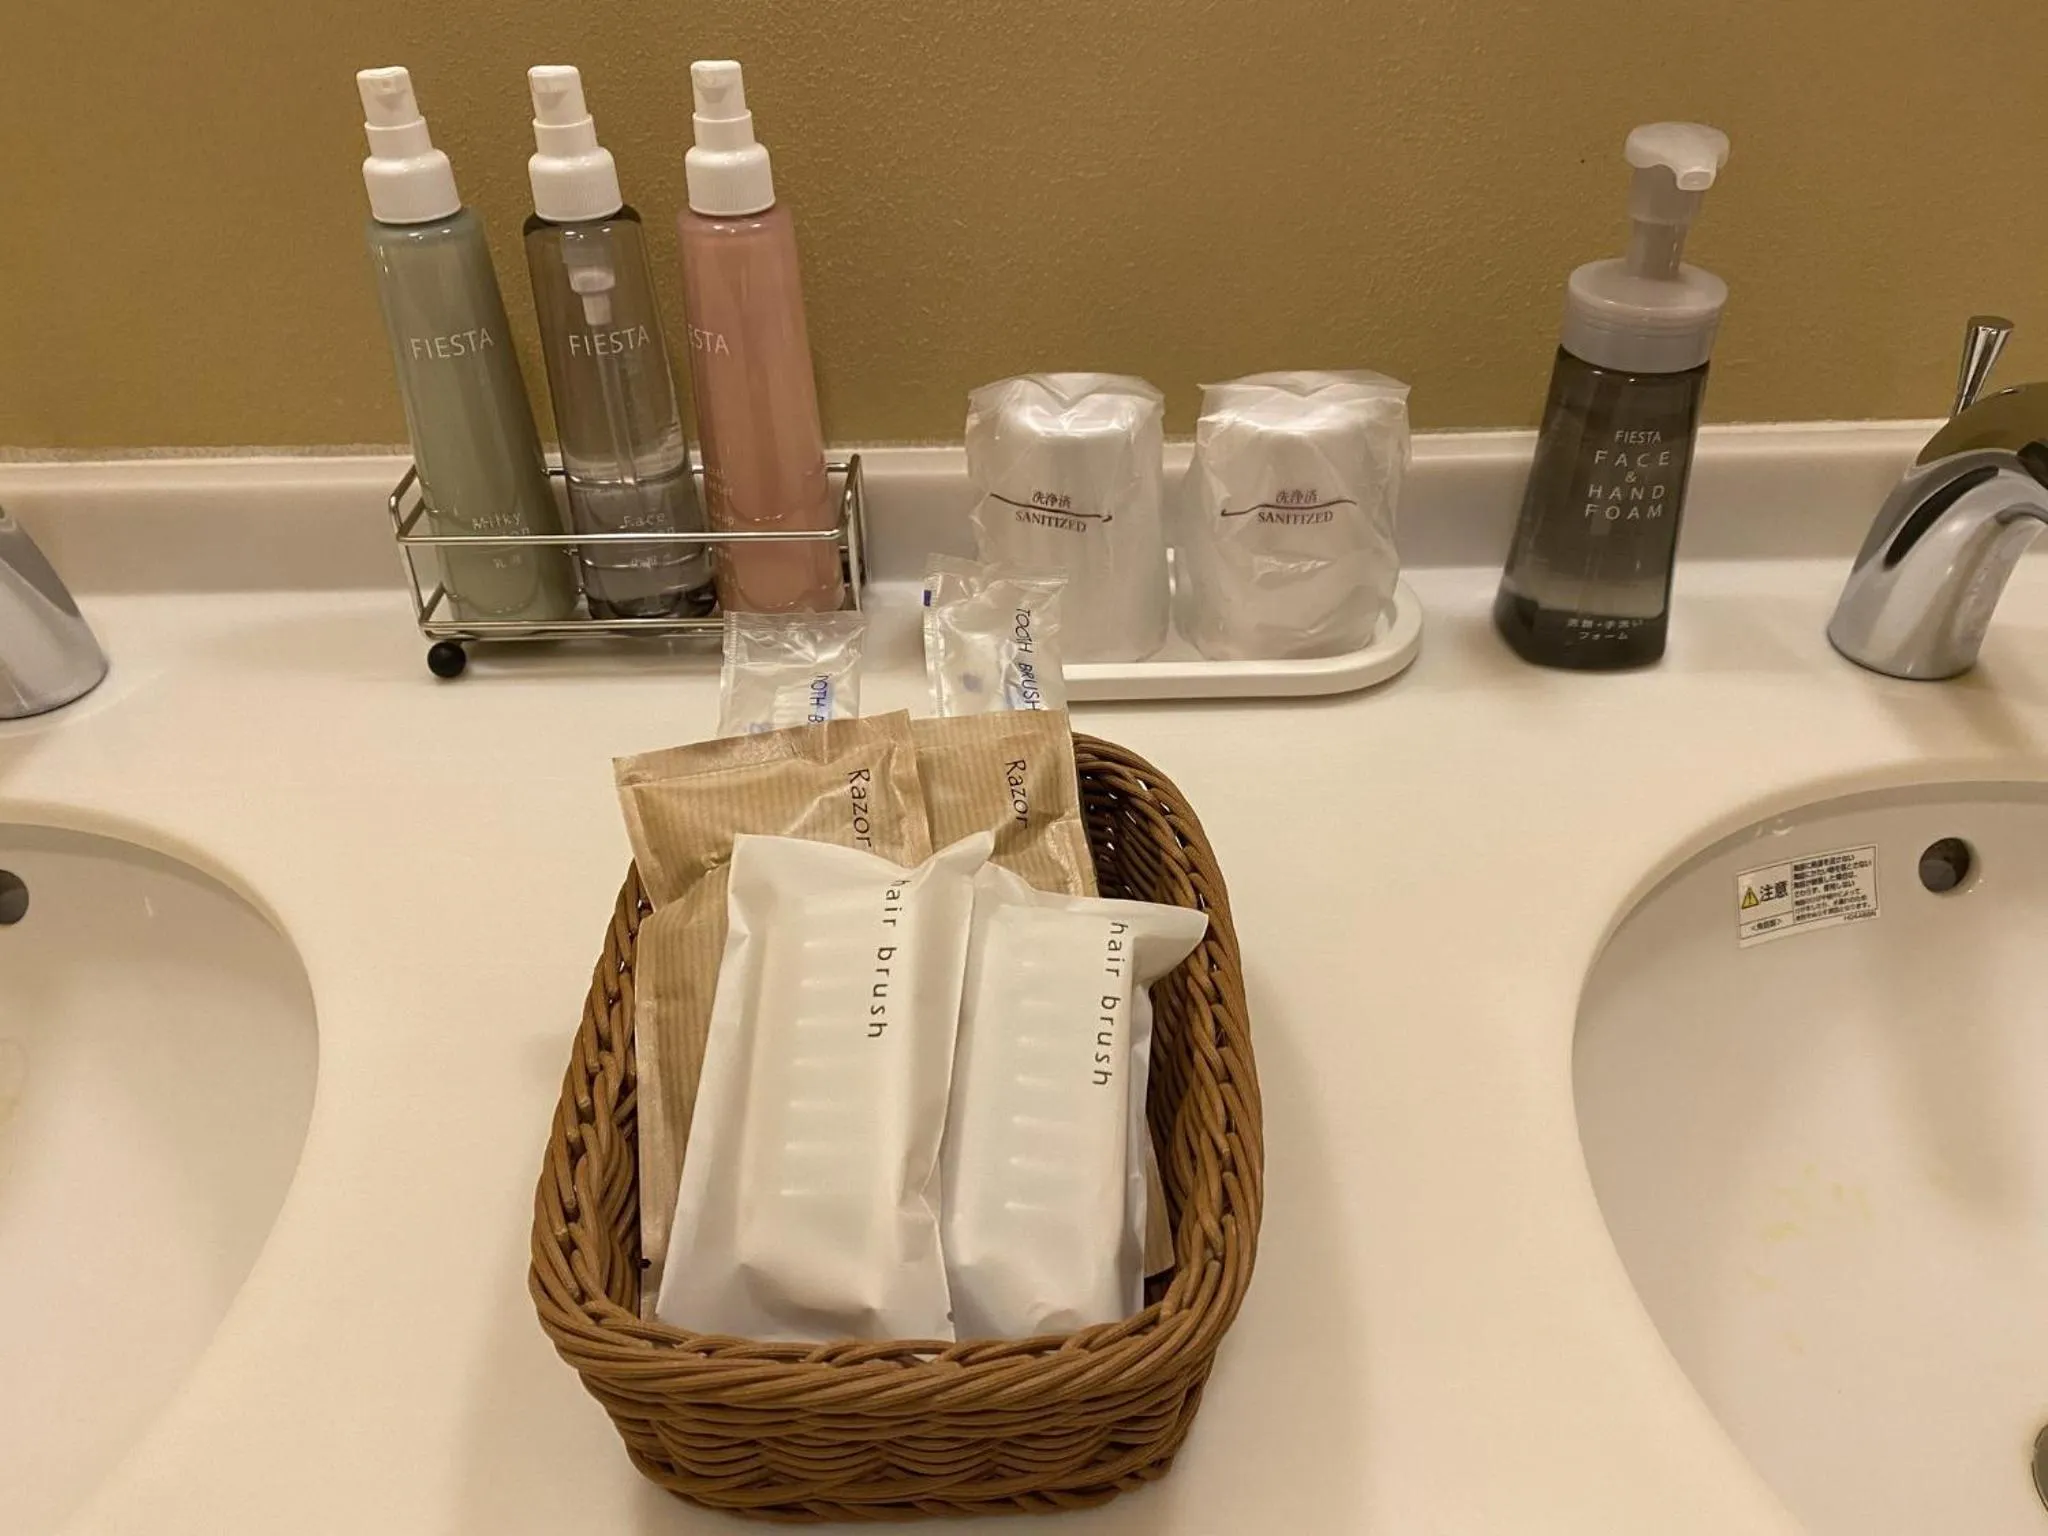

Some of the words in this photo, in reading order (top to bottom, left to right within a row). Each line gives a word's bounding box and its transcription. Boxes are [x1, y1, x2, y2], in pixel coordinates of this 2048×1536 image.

[411, 327, 494, 361] FIESTA
[569, 325, 651, 356] FIESTA
[1614, 430, 1662, 444] FIESTA
[1594, 450, 1672, 467] FACE
[1589, 484, 1665, 501] HAND
[1625, 471, 1637, 483] &
[1015, 510, 1087, 533] SANITIZED
[1258, 510, 1333, 525] SANITIZED
[1585, 503, 1663, 520] FOAM
[1018, 662, 1040, 710] BRUSH
[848, 768, 872, 848] Razor
[1004, 759, 1029, 830] Razor
[882, 879, 912, 927] hair
[1760, 881, 1788, 902] 注意
[1105, 921, 1129, 978] hair
[867, 947, 897, 1038] brush
[1092, 995, 1121, 1086] brush
